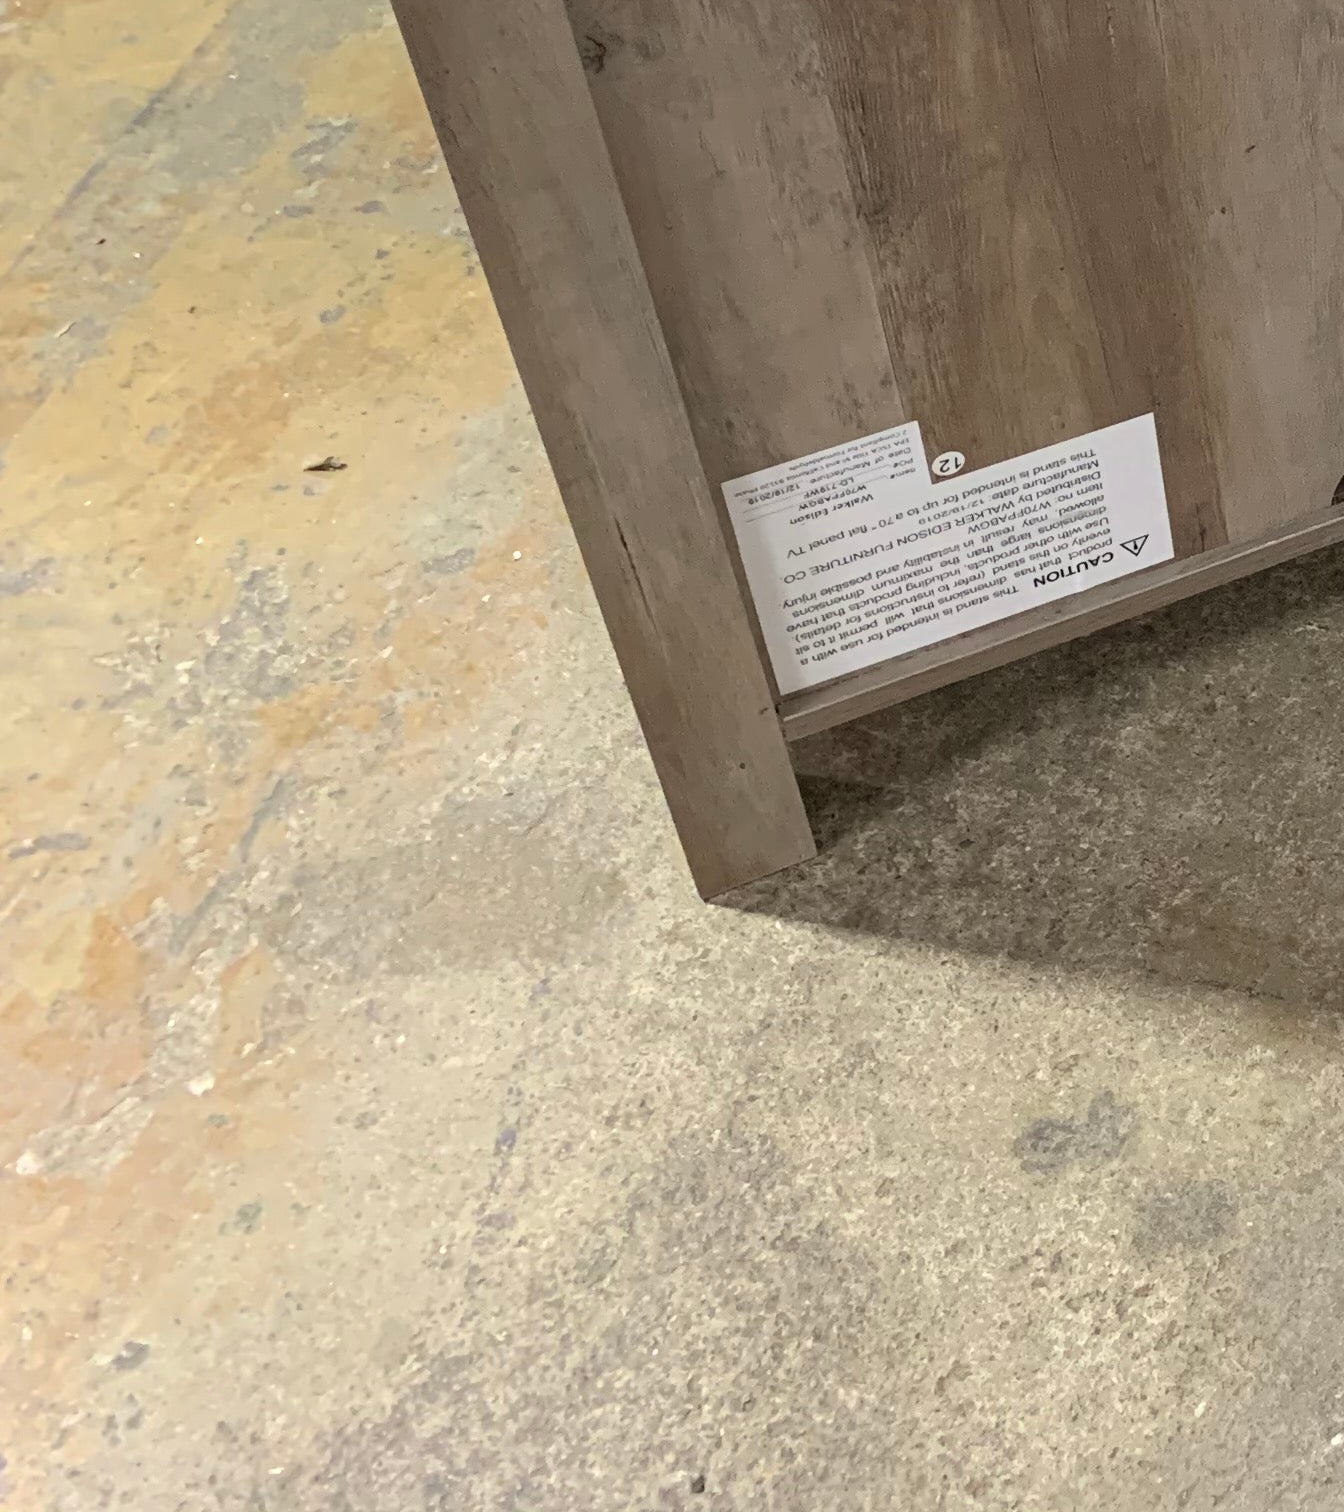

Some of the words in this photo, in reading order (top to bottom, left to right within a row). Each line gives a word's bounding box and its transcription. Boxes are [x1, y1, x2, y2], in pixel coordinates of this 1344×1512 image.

[873, 455, 884, 464] of
[887, 446, 911, 459] Date
[1069, 447, 1096, 463] This
[808, 459, 871, 485] Manufacture
[936, 453, 963, 475] 12
[1032, 457, 1067, 476] stand
[1018, 469, 1030, 481] is
[1021, 458, 1099, 491] Manufacture
[961, 473, 1016, 500] intended
[1035, 469, 1101, 499] Distributed
[1075, 481, 1103, 497] Item
[941, 493, 959, 507] for
[988, 484, 1020, 503] date:
[1016, 491, 1033, 505] by
[1054, 491, 1073, 504] no:
[831, 492, 873, 513] Walker
[921, 498, 939, 512] up
[1054, 493, 1105, 517] allowed,
[788, 507, 829, 527] Edison
[894, 511, 904, 521] a
[905, 506, 919, 517] to
[953, 498, 1015, 527] WALKER
[966, 498, 1051, 534] W70FPABGW
[1020, 511, 1048, 528] may
[1037, 504, 1107, 535] dimensions
[847, 524, 868, 538] flat
[1083, 516, 1108, 531] Use
[806, 529, 845, 552] panel
[895, 520, 952, 547] EDISON
[980, 524, 1015, 543] result
[999, 529, 1031, 548] large
[1057, 525, 1082, 541] with
[1070, 526, 1111, 547] evenly
[785, 544, 806, 559] TV
[962, 538, 974, 549] in
[966, 544, 994, 560] than
[1022, 534, 1055, 553] other
[1052, 541, 1069, 553] on
[1067, 537, 1113, 560] product
[807, 539, 894, 576] FURNITURE
[901, 541, 960, 570] instability
[938, 555, 960, 569] the
[962, 545, 1020, 573] products,
[1028, 548, 1050, 562] this
[1038, 555, 1062, 571] that
[874, 563, 900, 578] and
[991, 556, 1026, 576] stand
[1013, 565, 1036, 579] has
[1032, 550, 1114, 588] CAUTION
[818, 571, 872, 598] possible
[870, 564, 933, 592] maximum
[904, 566, 960, 593] including
[952, 569, 986, 589] (refer
[936, 574, 1008, 606] dimensions
[937, 583, 949, 593] to
[992, 584, 1018, 600] This
[790, 587, 865, 619] dimensions
[847, 585, 903, 612] products
[863, 588, 935, 619] instructions
[955, 594, 990, 613] stand
[820, 606, 845, 622] that
[910, 600, 934, 615] that
[941, 606, 953, 617] is
[785, 616, 818, 634] have
[844, 613, 861, 626] for
[884, 611, 904, 624] will
[885, 611, 940, 637] intended
[791, 619, 842, 644] details).
[837, 618, 878, 640] permit
[865, 630, 883, 644] for
[812, 638, 825, 649] to
[827, 634, 836, 644] it
[839, 637, 863, 651] use
[794, 644, 810, 655] sit
[811, 646, 837, 662] with
[799, 657, 808, 665] a
